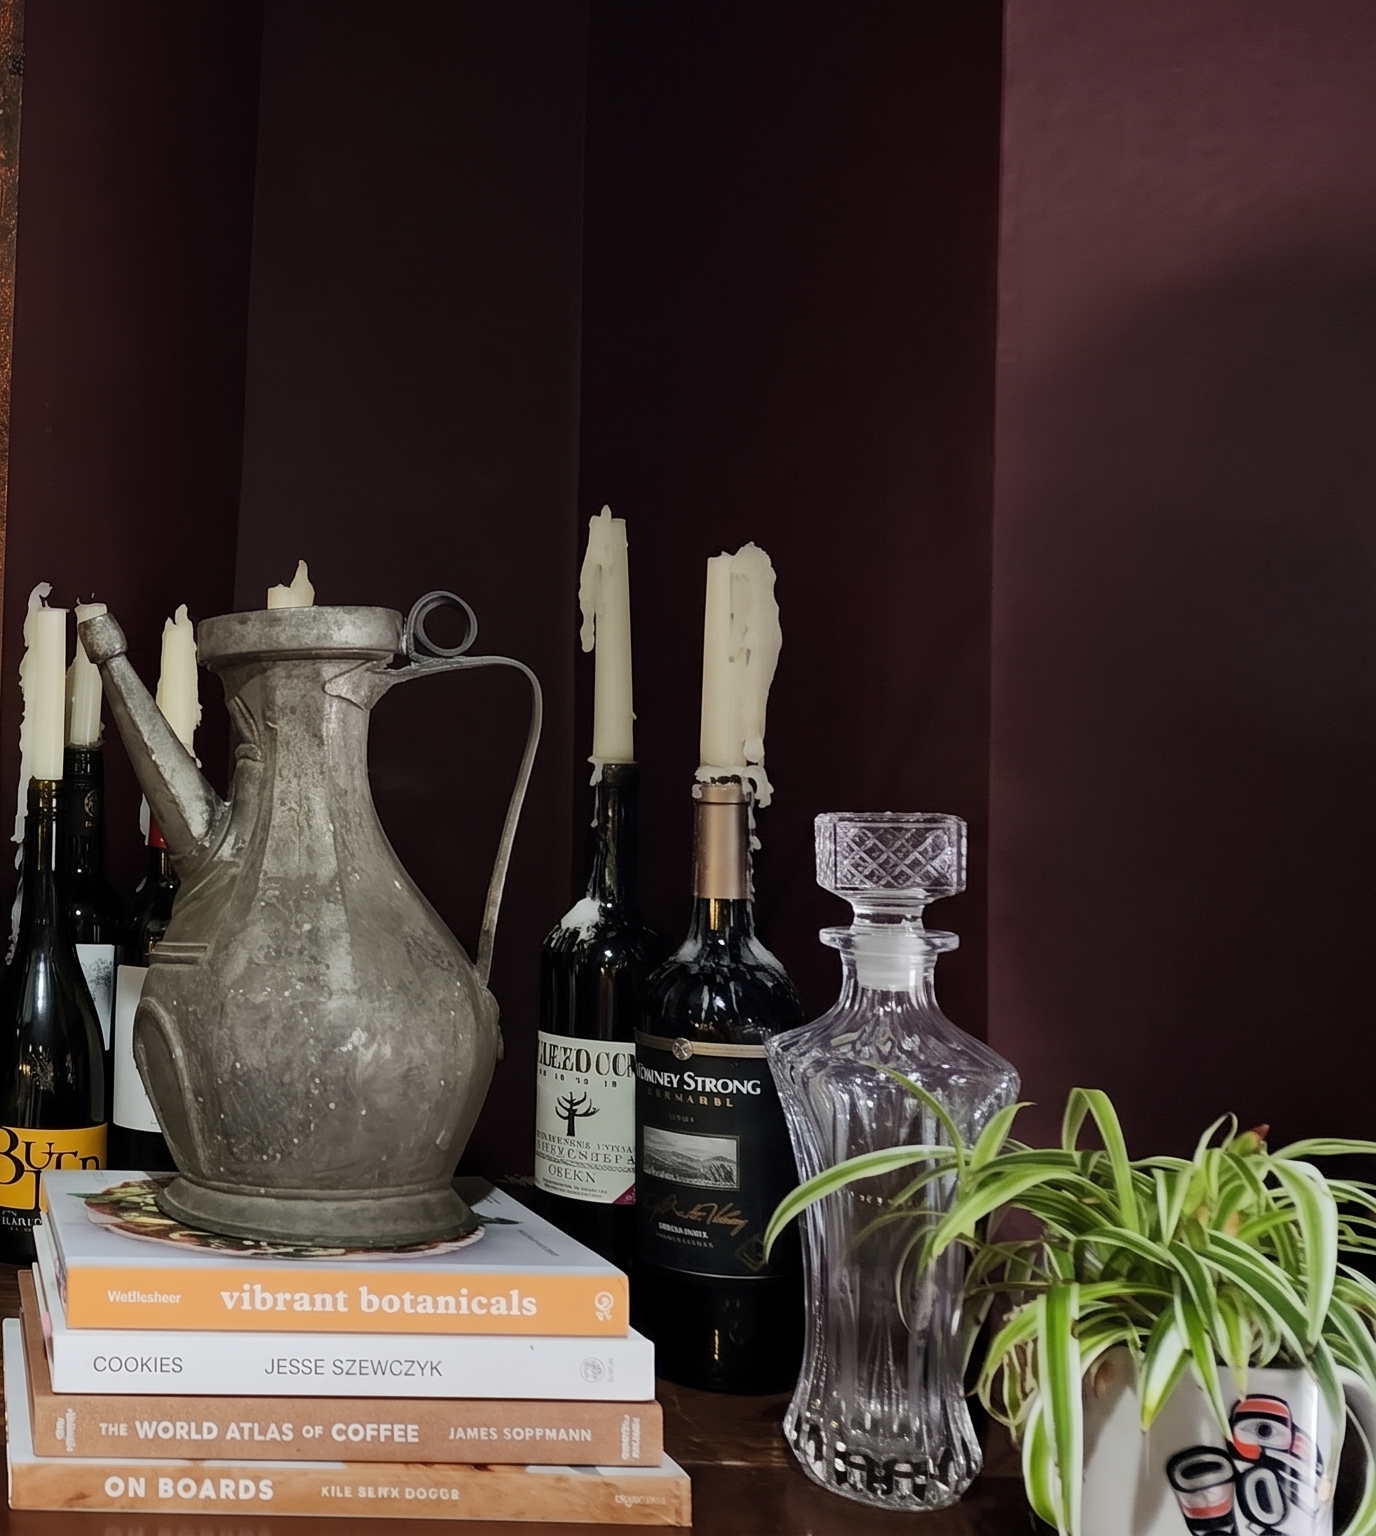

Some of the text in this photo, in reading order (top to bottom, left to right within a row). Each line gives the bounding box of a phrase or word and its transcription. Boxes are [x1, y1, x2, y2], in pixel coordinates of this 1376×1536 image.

[684, 1071, 761, 1095] STRONG
[220, 1283, 349, 1312] vibrant
[359, 1286, 537, 1316] botanicals
[93, 1356, 443, 1377] COOKIES JESSE SZEWCZYK
[99, 1422, 128, 1436] THE
[135, 1420, 218, 1440] WORLD
[225, 1422, 294, 1441] ATLAS
[302, 1425, 323, 1439] OF
[331, 1423, 420, 1443] COFFEE
[449, 1427, 498, 1440] JAMES
[104, 1476, 146, 1498] ON
[157, 1477, 274, 1500] BOARDS
